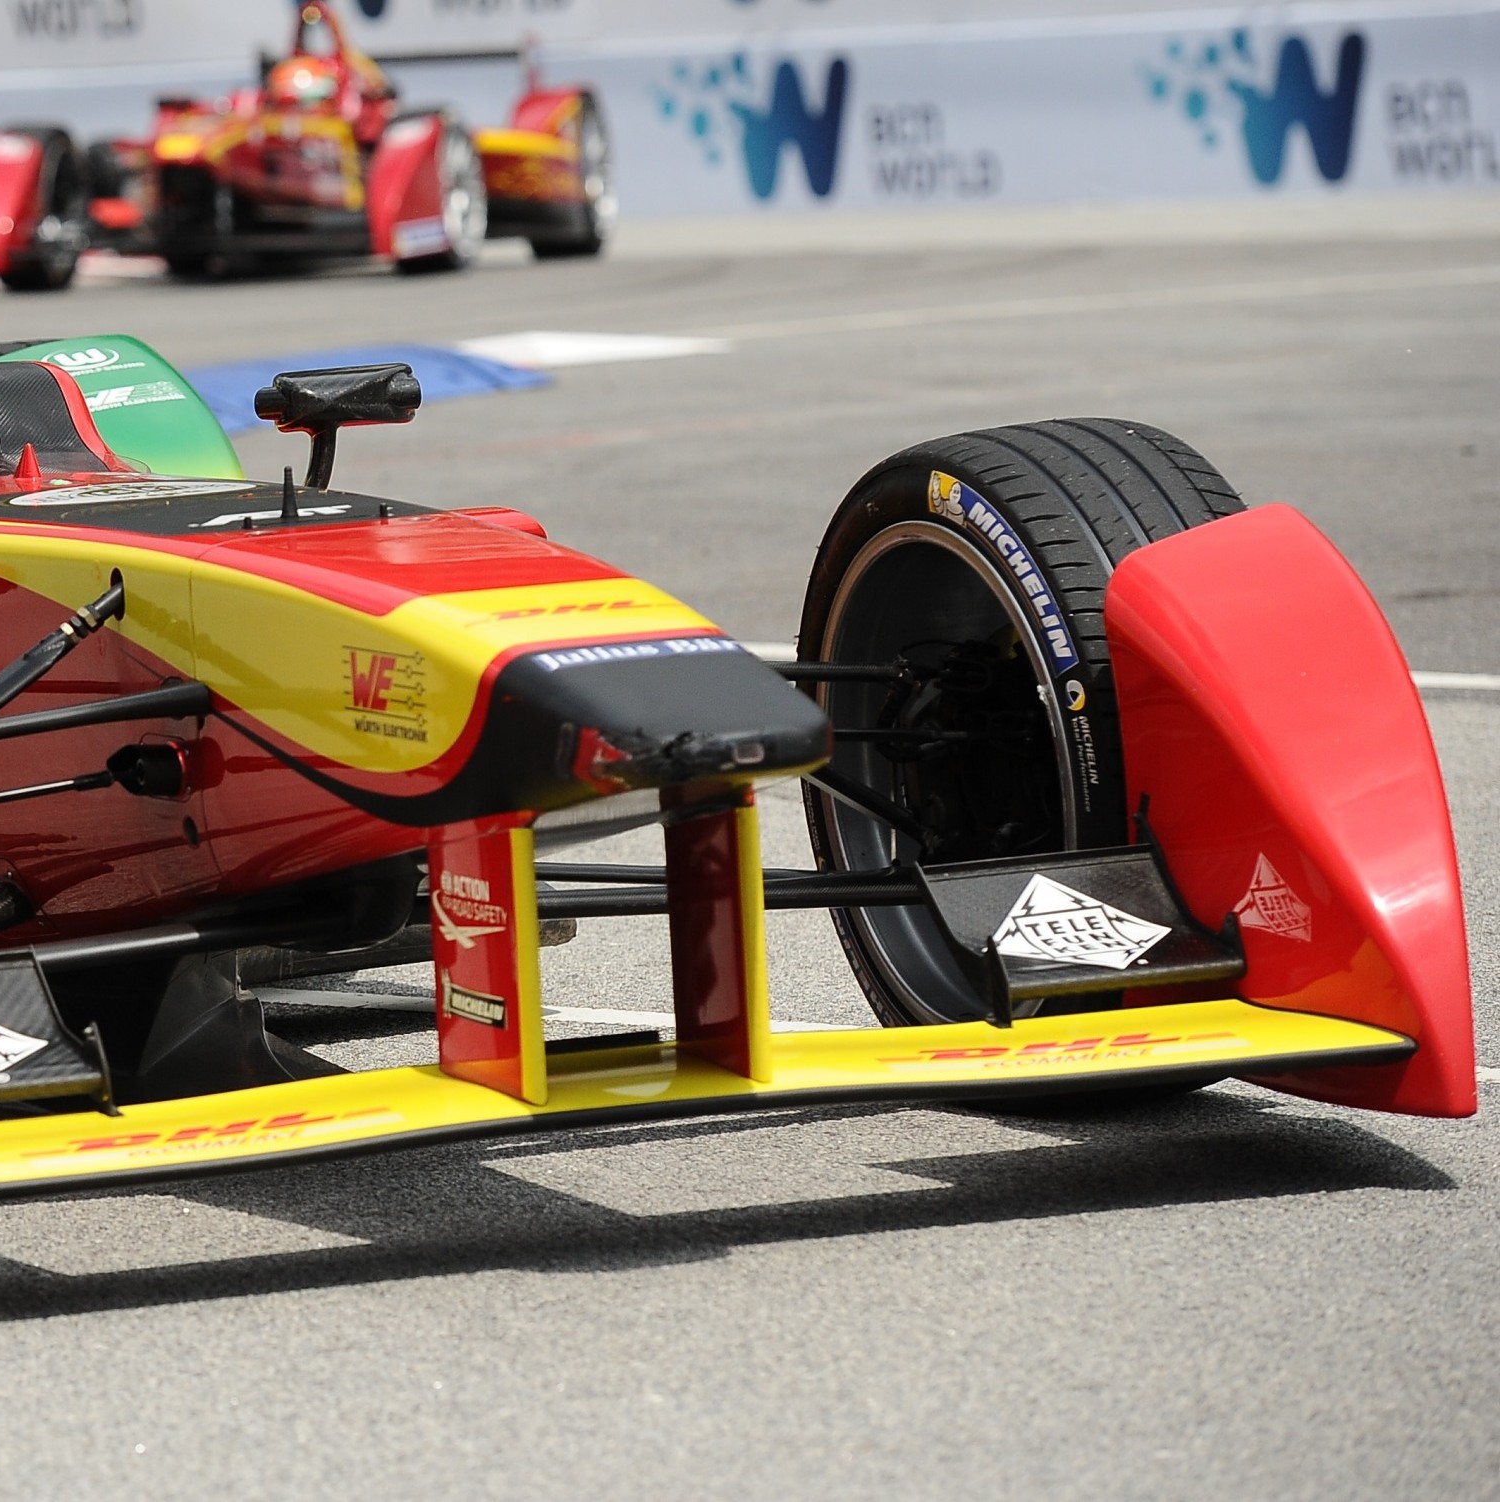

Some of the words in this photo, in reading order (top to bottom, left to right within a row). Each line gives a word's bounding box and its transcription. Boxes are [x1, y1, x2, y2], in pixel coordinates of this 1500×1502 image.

[968, 501, 1073, 659] MICHELIN
[490, 600, 651, 621] DHL
[538, 644, 660, 672] Julius
[350, 650, 397, 712] WE
[1078, 715, 1100, 785] MICHELIN
[1025, 915, 1104, 937] TELE
[452, 990, 504, 1022] MICHELIN
[919, 1032, 1182, 1061] DHL
[69, 1112, 335, 1152] DHL
